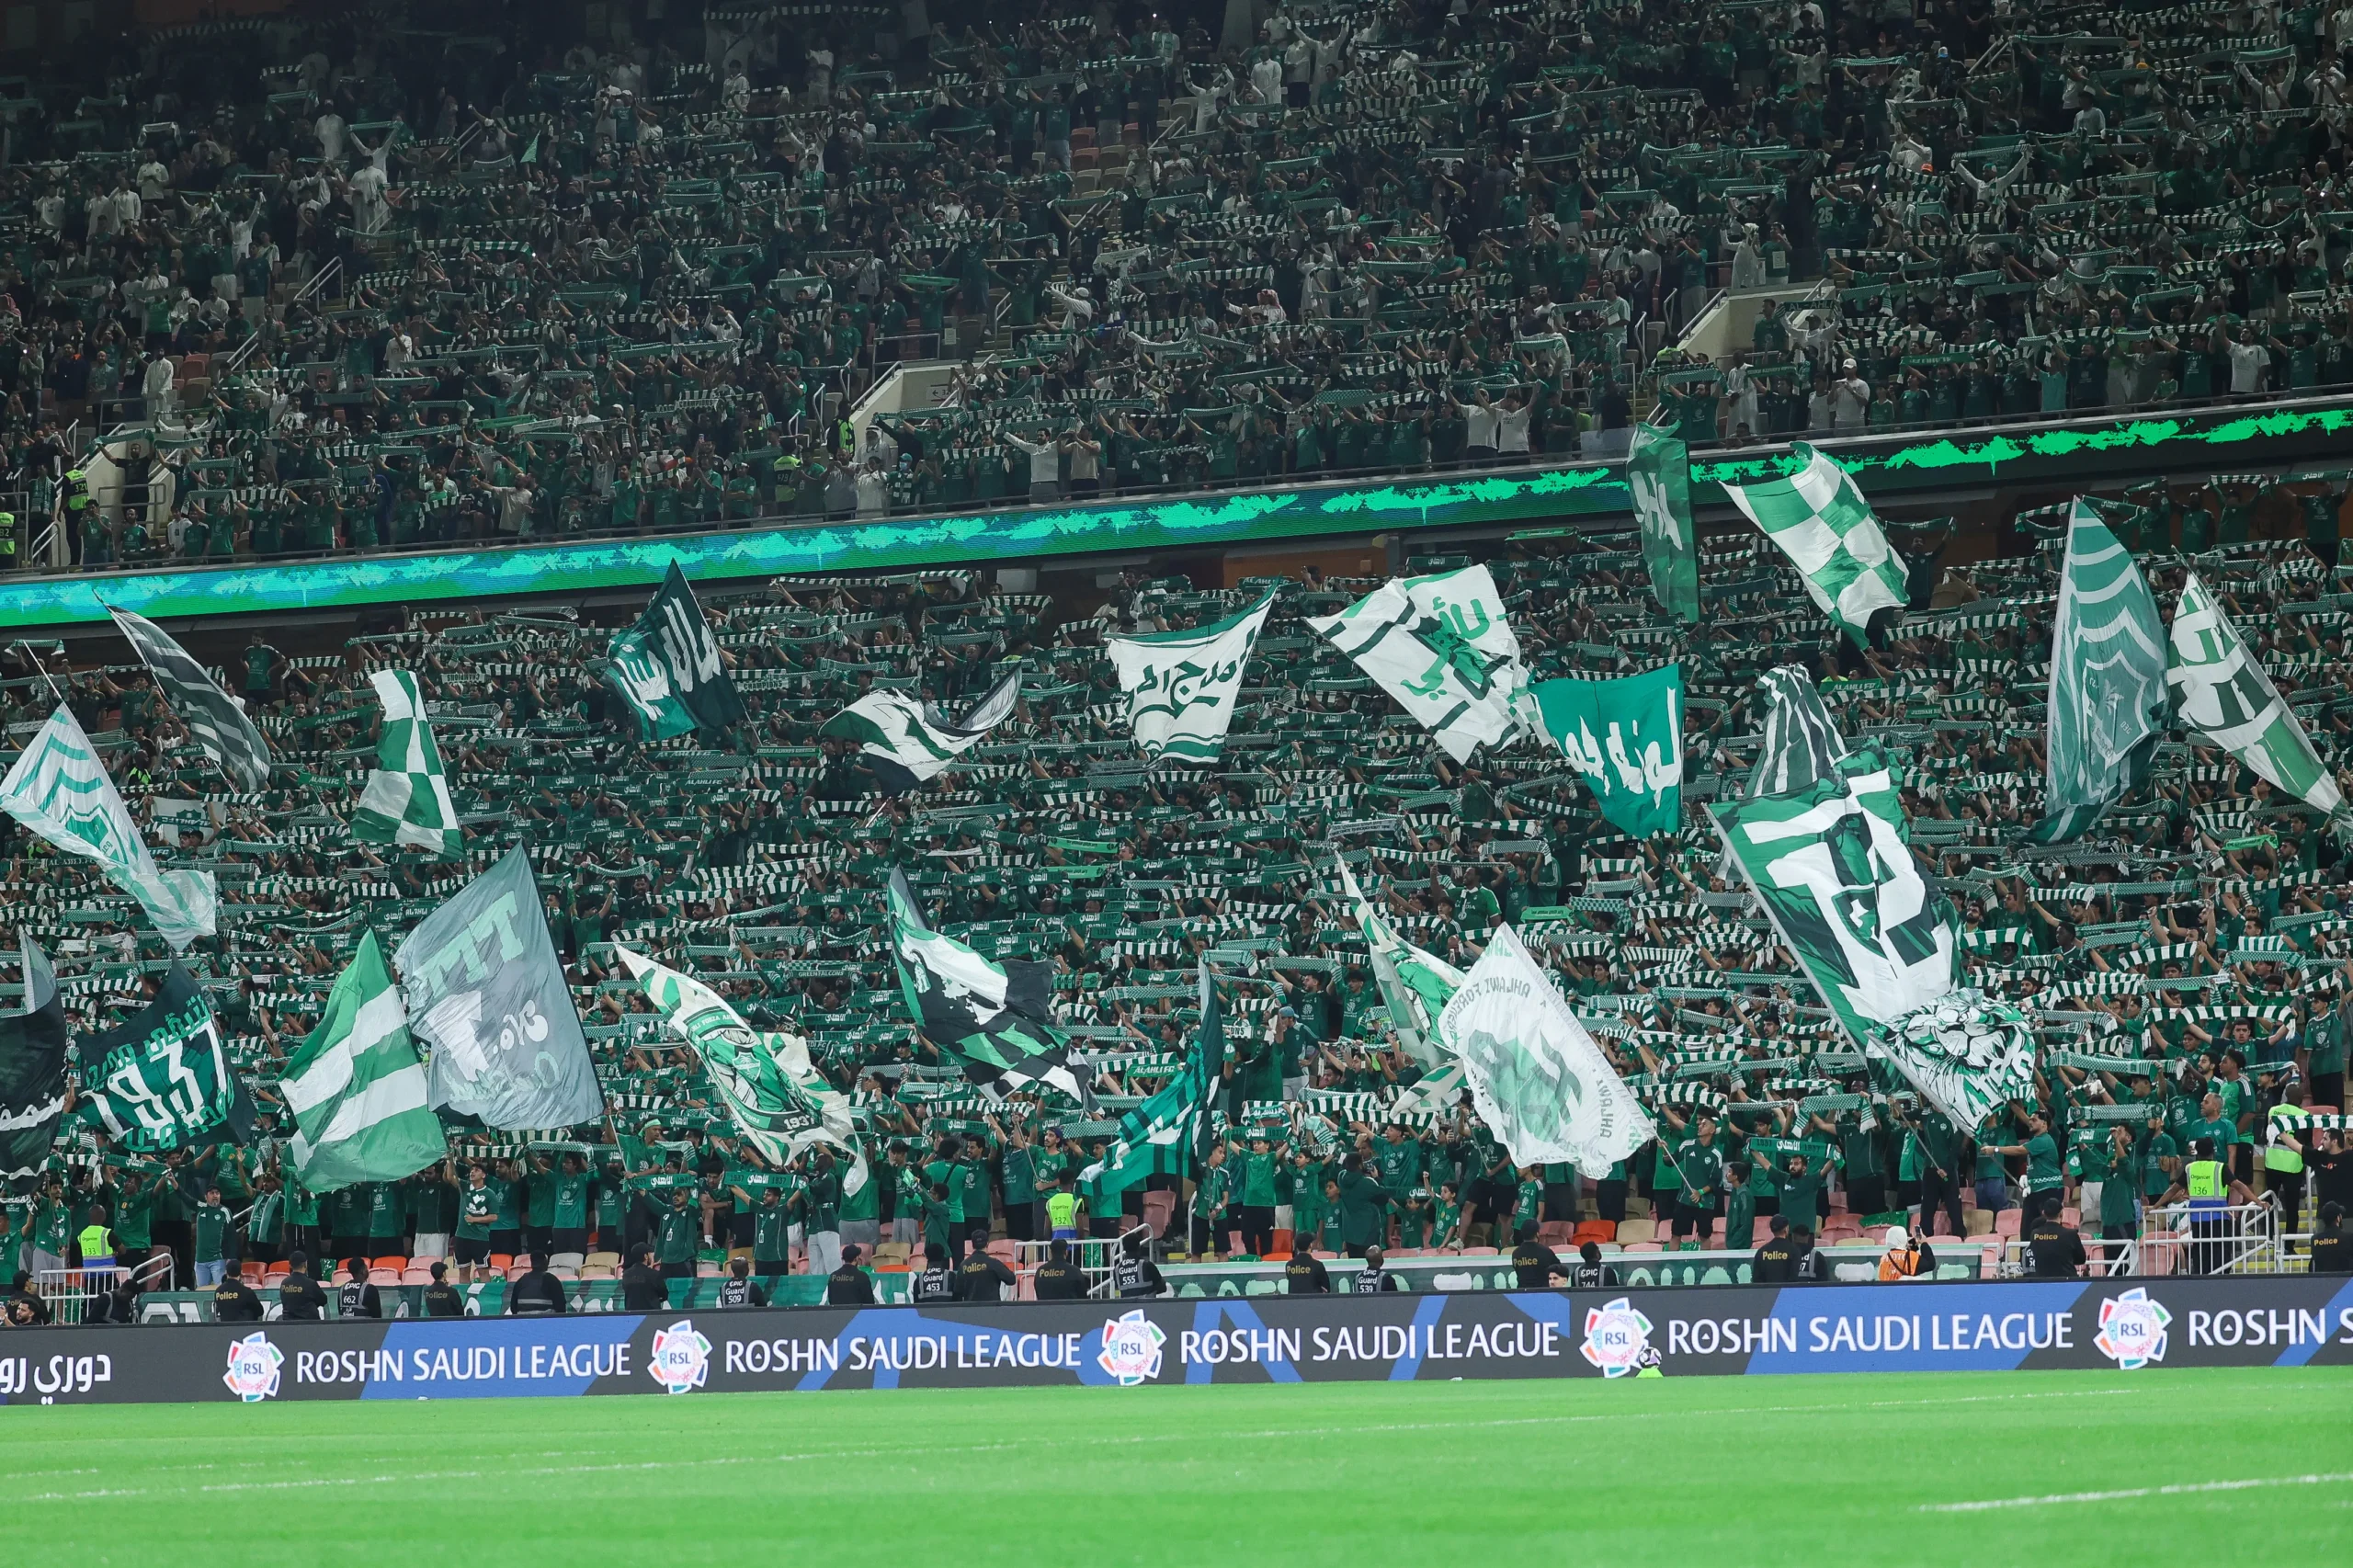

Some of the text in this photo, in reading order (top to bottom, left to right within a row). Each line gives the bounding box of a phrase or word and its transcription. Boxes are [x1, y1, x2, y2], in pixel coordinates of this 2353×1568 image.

[1818, 207, 1833, 223] 25
[744, 680, 782, 690] CHAMPIONS
[2193, 1186, 2208, 1196] 136
[2313, 1238, 2337, 1246] Police
[85, 1247, 97, 1256] 133
[1762, 1251, 1788, 1261] Police
[1513, 1257, 1538, 1267] Police
[963, 1263, 987, 1274] Police
[1040, 1268, 1064, 1278] Police
[1119, 1266, 1138, 1276] Guard
[1287, 1266, 1311, 1275] Police
[832, 1274, 854, 1282] Police
[924, 1274, 943, 1283] Guard
[1122, 1275, 1136, 1286] 555
[1358, 1276, 1378, 1285] Guard
[280, 1285, 303, 1294] Police
[725, 1287, 745, 1296] Guard
[926, 1283, 940, 1291] 453
[1359, 1285, 1373, 1293] 539
[215, 1290, 239, 1301] Police
[425, 1290, 449, 1301] Police
[727, 1295, 742, 1304] 509
[2122, 1323, 2146, 1336] RSL
[2189, 1310, 2325, 1346] ROSHN
[1669, 1313, 2073, 1354] ROSHN SAUDI LEAGUE
[1182, 1323, 1559, 1363] ROSHN SAUDI LEAGUE
[1605, 1332, 1629, 1346] RSL
[727, 1334, 1081, 1372] ROSHN SAUDI LEAGUE
[1120, 1343, 1143, 1356] RSL
[298, 1344, 631, 1381] ROSHN SAUDI LEAGUE
[669, 1353, 690, 1366] RSL
[244, 1362, 265, 1375] RSL
[0, 1355, 110, 1404] دوري رو
